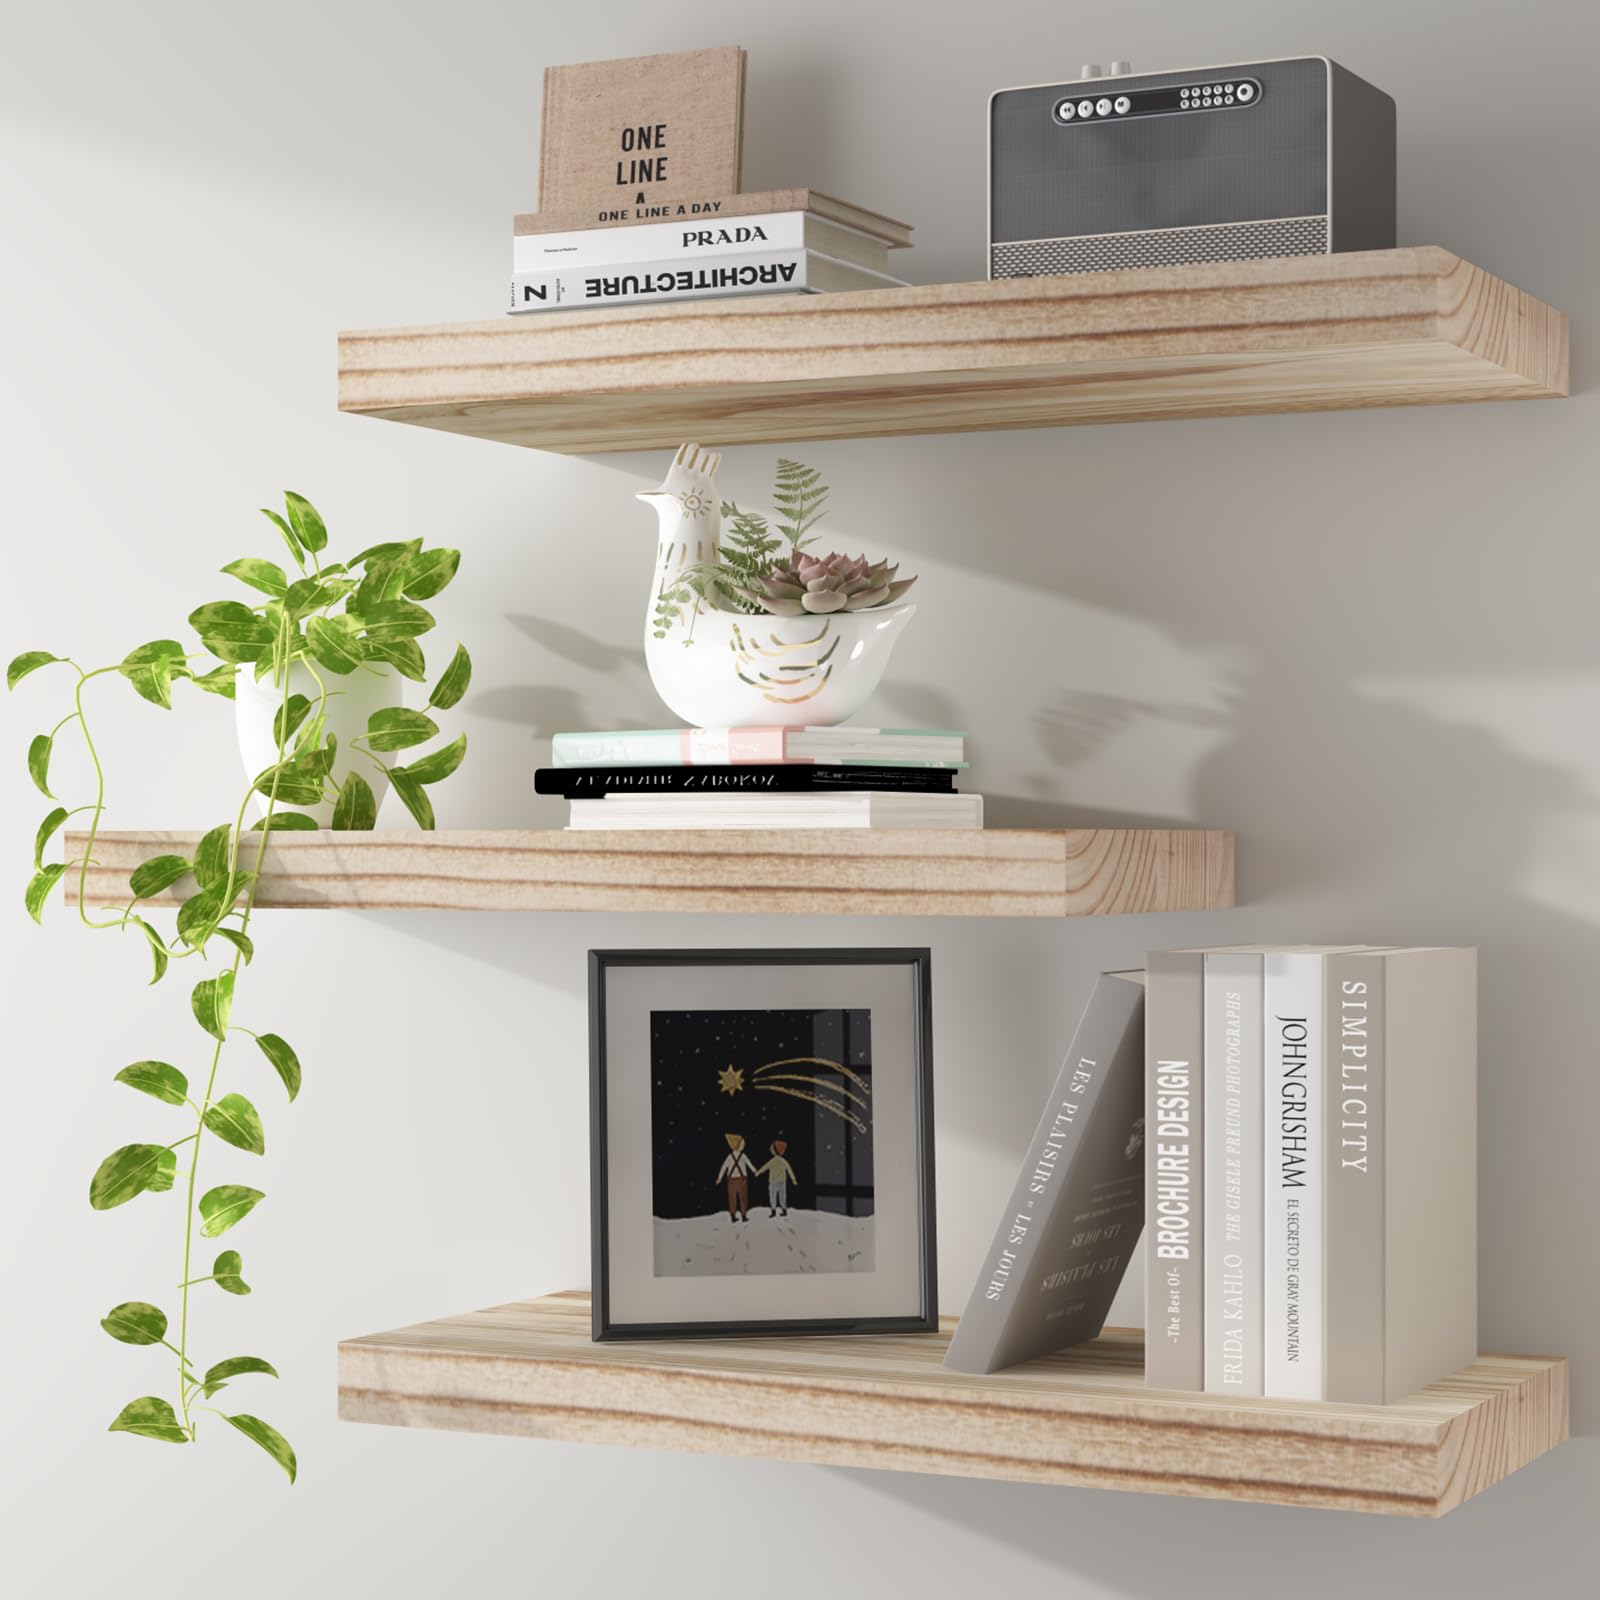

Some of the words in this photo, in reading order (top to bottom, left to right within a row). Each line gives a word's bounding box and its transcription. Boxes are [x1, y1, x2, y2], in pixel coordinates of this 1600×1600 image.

[621, 124, 667, 152] ONE
[616, 157, 668, 185] LINE
[598, 209, 628, 222] ONE
[635, 204, 670, 219] LINE
[676, 205, 686, 215] A
[691, 201, 722, 214] DAY
[635, 192, 645, 204] A
[682, 226, 768, 248] PRADA
[584, 262, 798, 298] ARCHITECTURE
[1225, 991, 1241, 1095] PHOTOGRAPHS
[1069, 1056, 1097, 1094] LES
[1341, 981, 1368, 1173] SIMPLICITY
[1156, 1060, 1190, 1137] DESIGN
[1225, 1098, 1241, 1155] FREUND
[1029, 1102, 1079, 1194] PLAISIRS
[1156, 1143, 1190, 1260] BROCHURE
[1225, 1159, 1241, 1209] GISELE
[1287, 1198, 1300, 1209] EL
[1008, 1213, 1032, 1245] LES
[1225, 1214, 1241, 1241] THE
[1287, 1211, 1300, 1256] SECRETO
[984, 1249, 1017, 1301] JOURS
[1287, 1258, 1300, 1272] DE
[1167, 1290, 1181, 1313] Best
[1223, 1253, 1244, 1321] KAHLO
[1287, 1274, 1300, 1302] GRAY
[1287, 1303, 1300, 1363] MOUNTAIN
[1223, 1328, 1244, 1385] FRIDA
